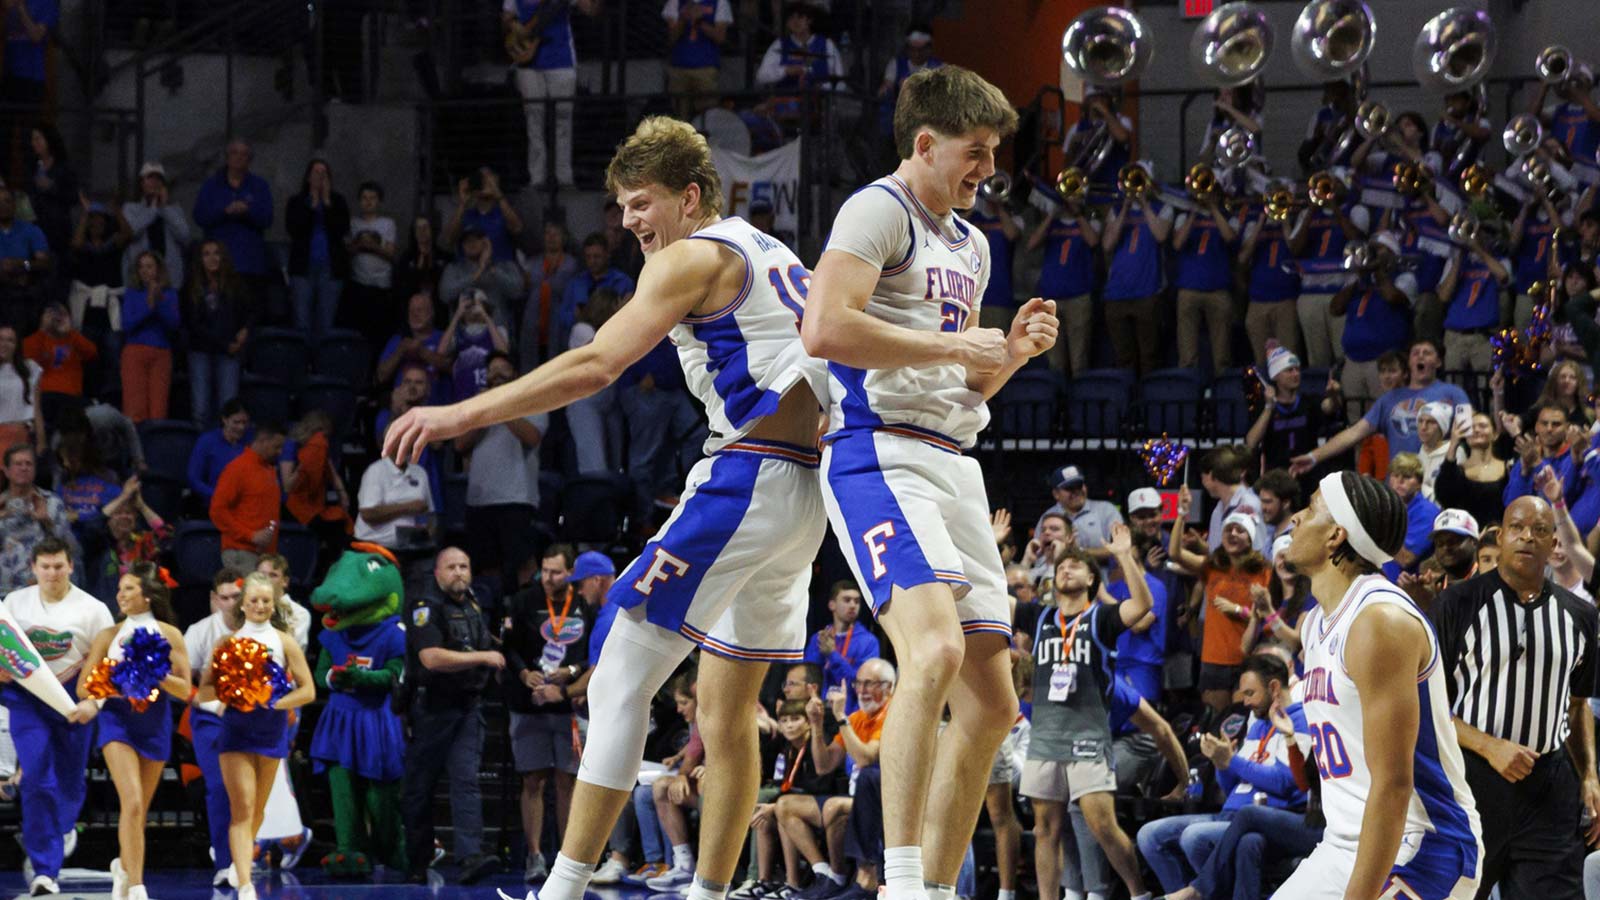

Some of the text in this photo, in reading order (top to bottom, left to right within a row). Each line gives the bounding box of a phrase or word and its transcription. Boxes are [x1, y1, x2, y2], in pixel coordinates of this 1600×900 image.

[633, 546, 692, 597] F
[862, 519, 896, 581] F
[1037, 636, 1092, 667] UTAH
